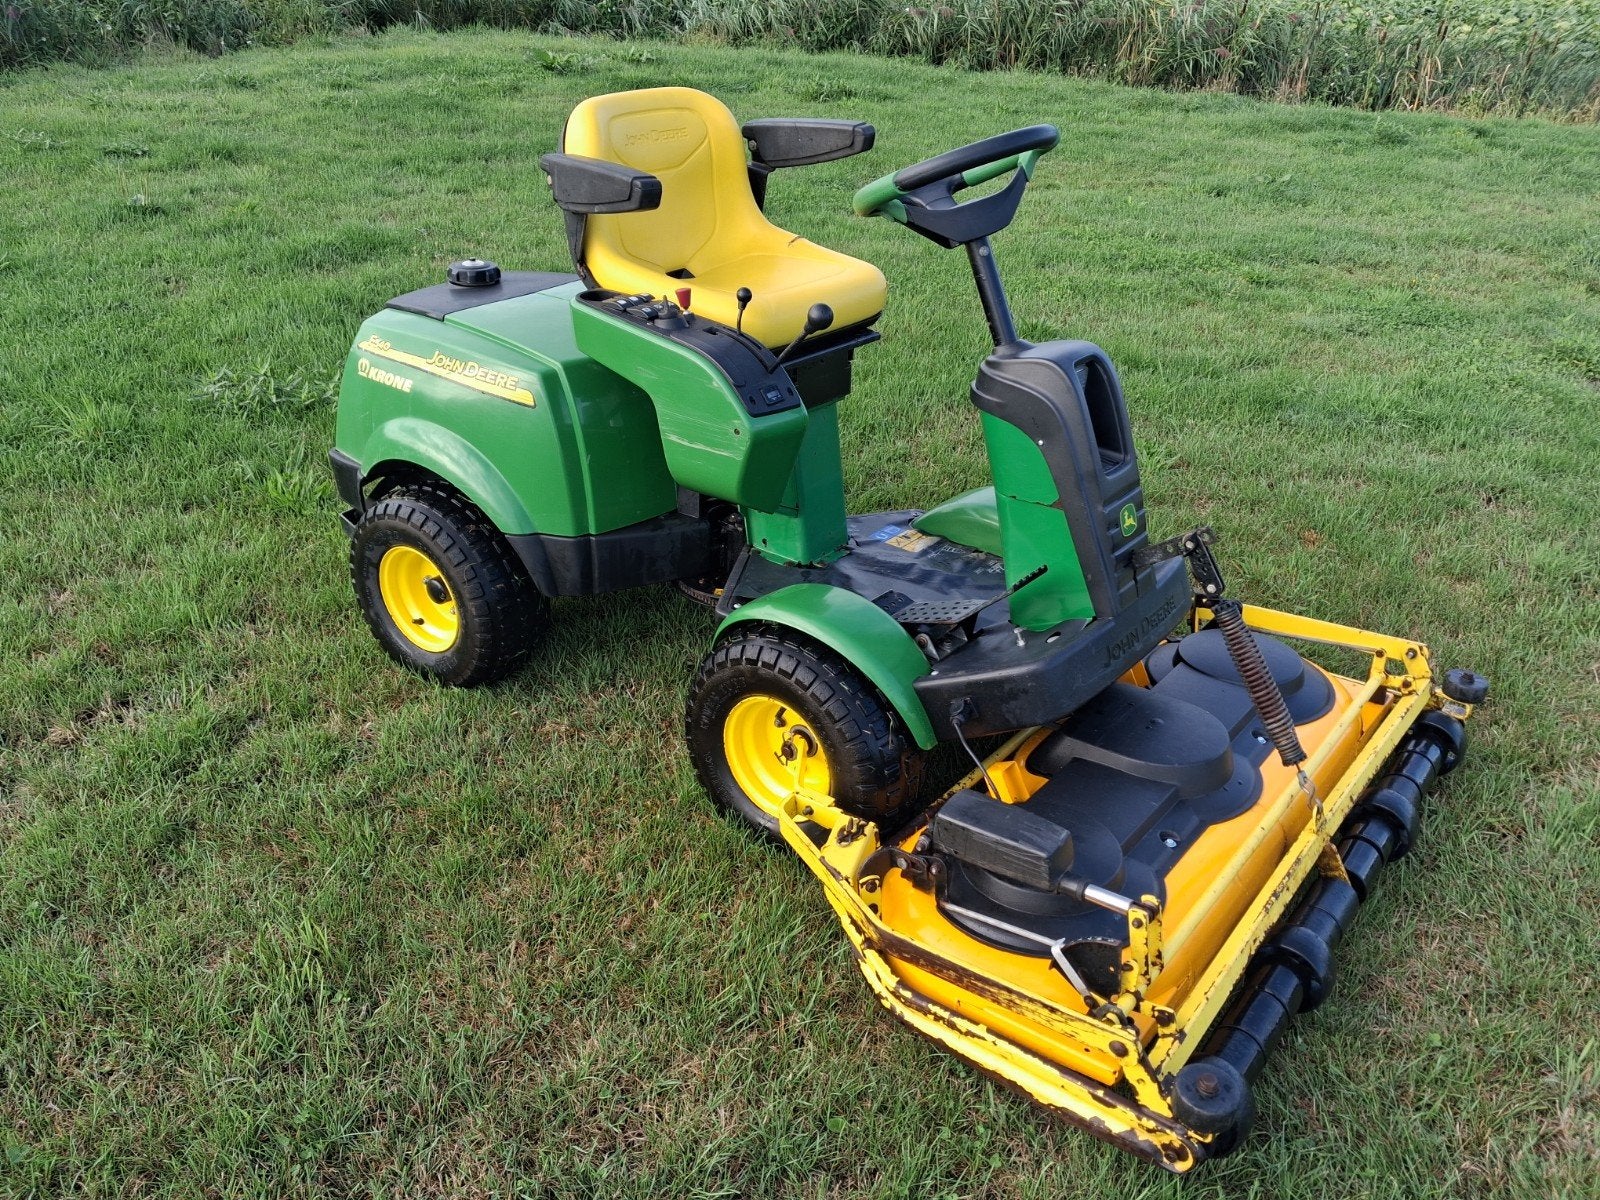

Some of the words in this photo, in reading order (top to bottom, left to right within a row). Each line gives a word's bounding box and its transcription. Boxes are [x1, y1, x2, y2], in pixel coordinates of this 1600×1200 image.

[624, 133, 650, 149] JOHN
[650, 127, 689, 143] DEERE
[367, 366, 413, 393] KRONE
[426, 351, 465, 375] JOHN
[463, 361, 519, 391] DEERE
[1103, 627, 1140, 668] JOHN
[1141, 594, 1176, 634] DEERE
